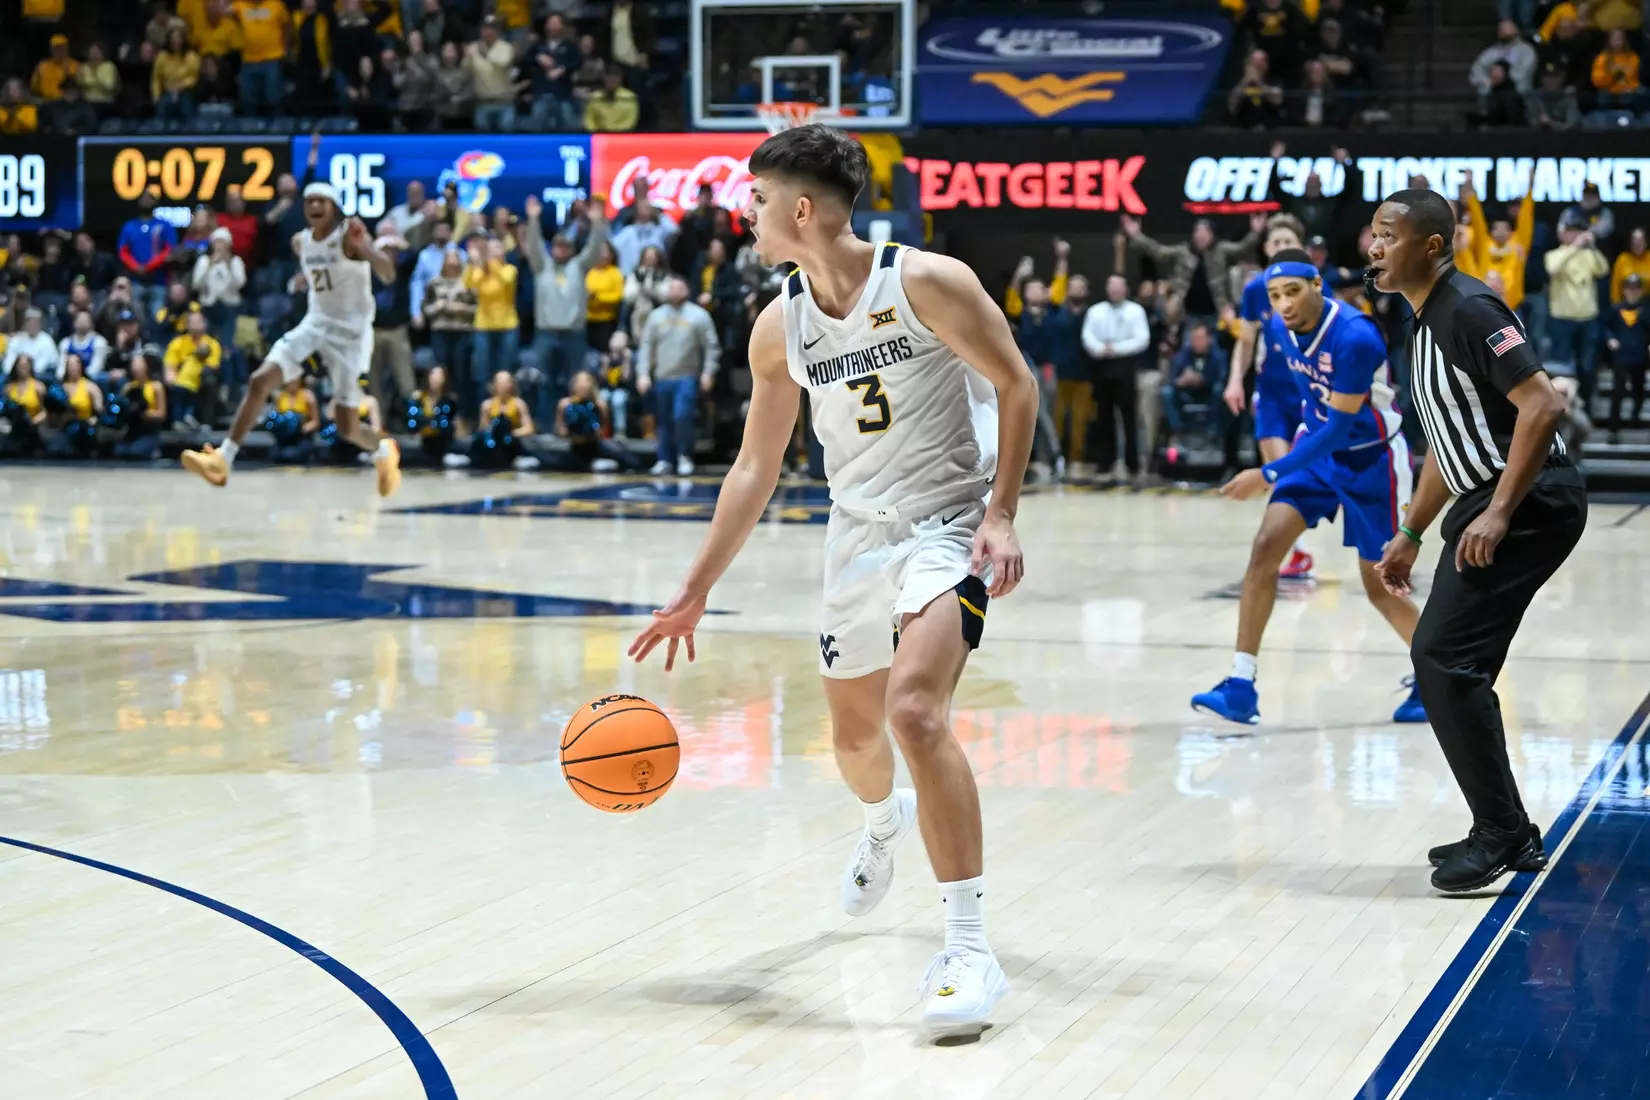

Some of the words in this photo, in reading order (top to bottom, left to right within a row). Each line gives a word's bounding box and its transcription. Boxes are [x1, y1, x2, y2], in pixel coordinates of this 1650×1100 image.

[0, 154, 45, 217] 89
[112, 147, 275, 200] 0:07.2
[330, 153, 385, 218] 85
[904, 156, 1147, 215] EATGEEK
[1357, 157, 1493, 202] TICKET
[311, 268, 333, 292] 21
[806, 336, 914, 387] MOUNTAINEERS
[845, 372, 892, 434] 3
